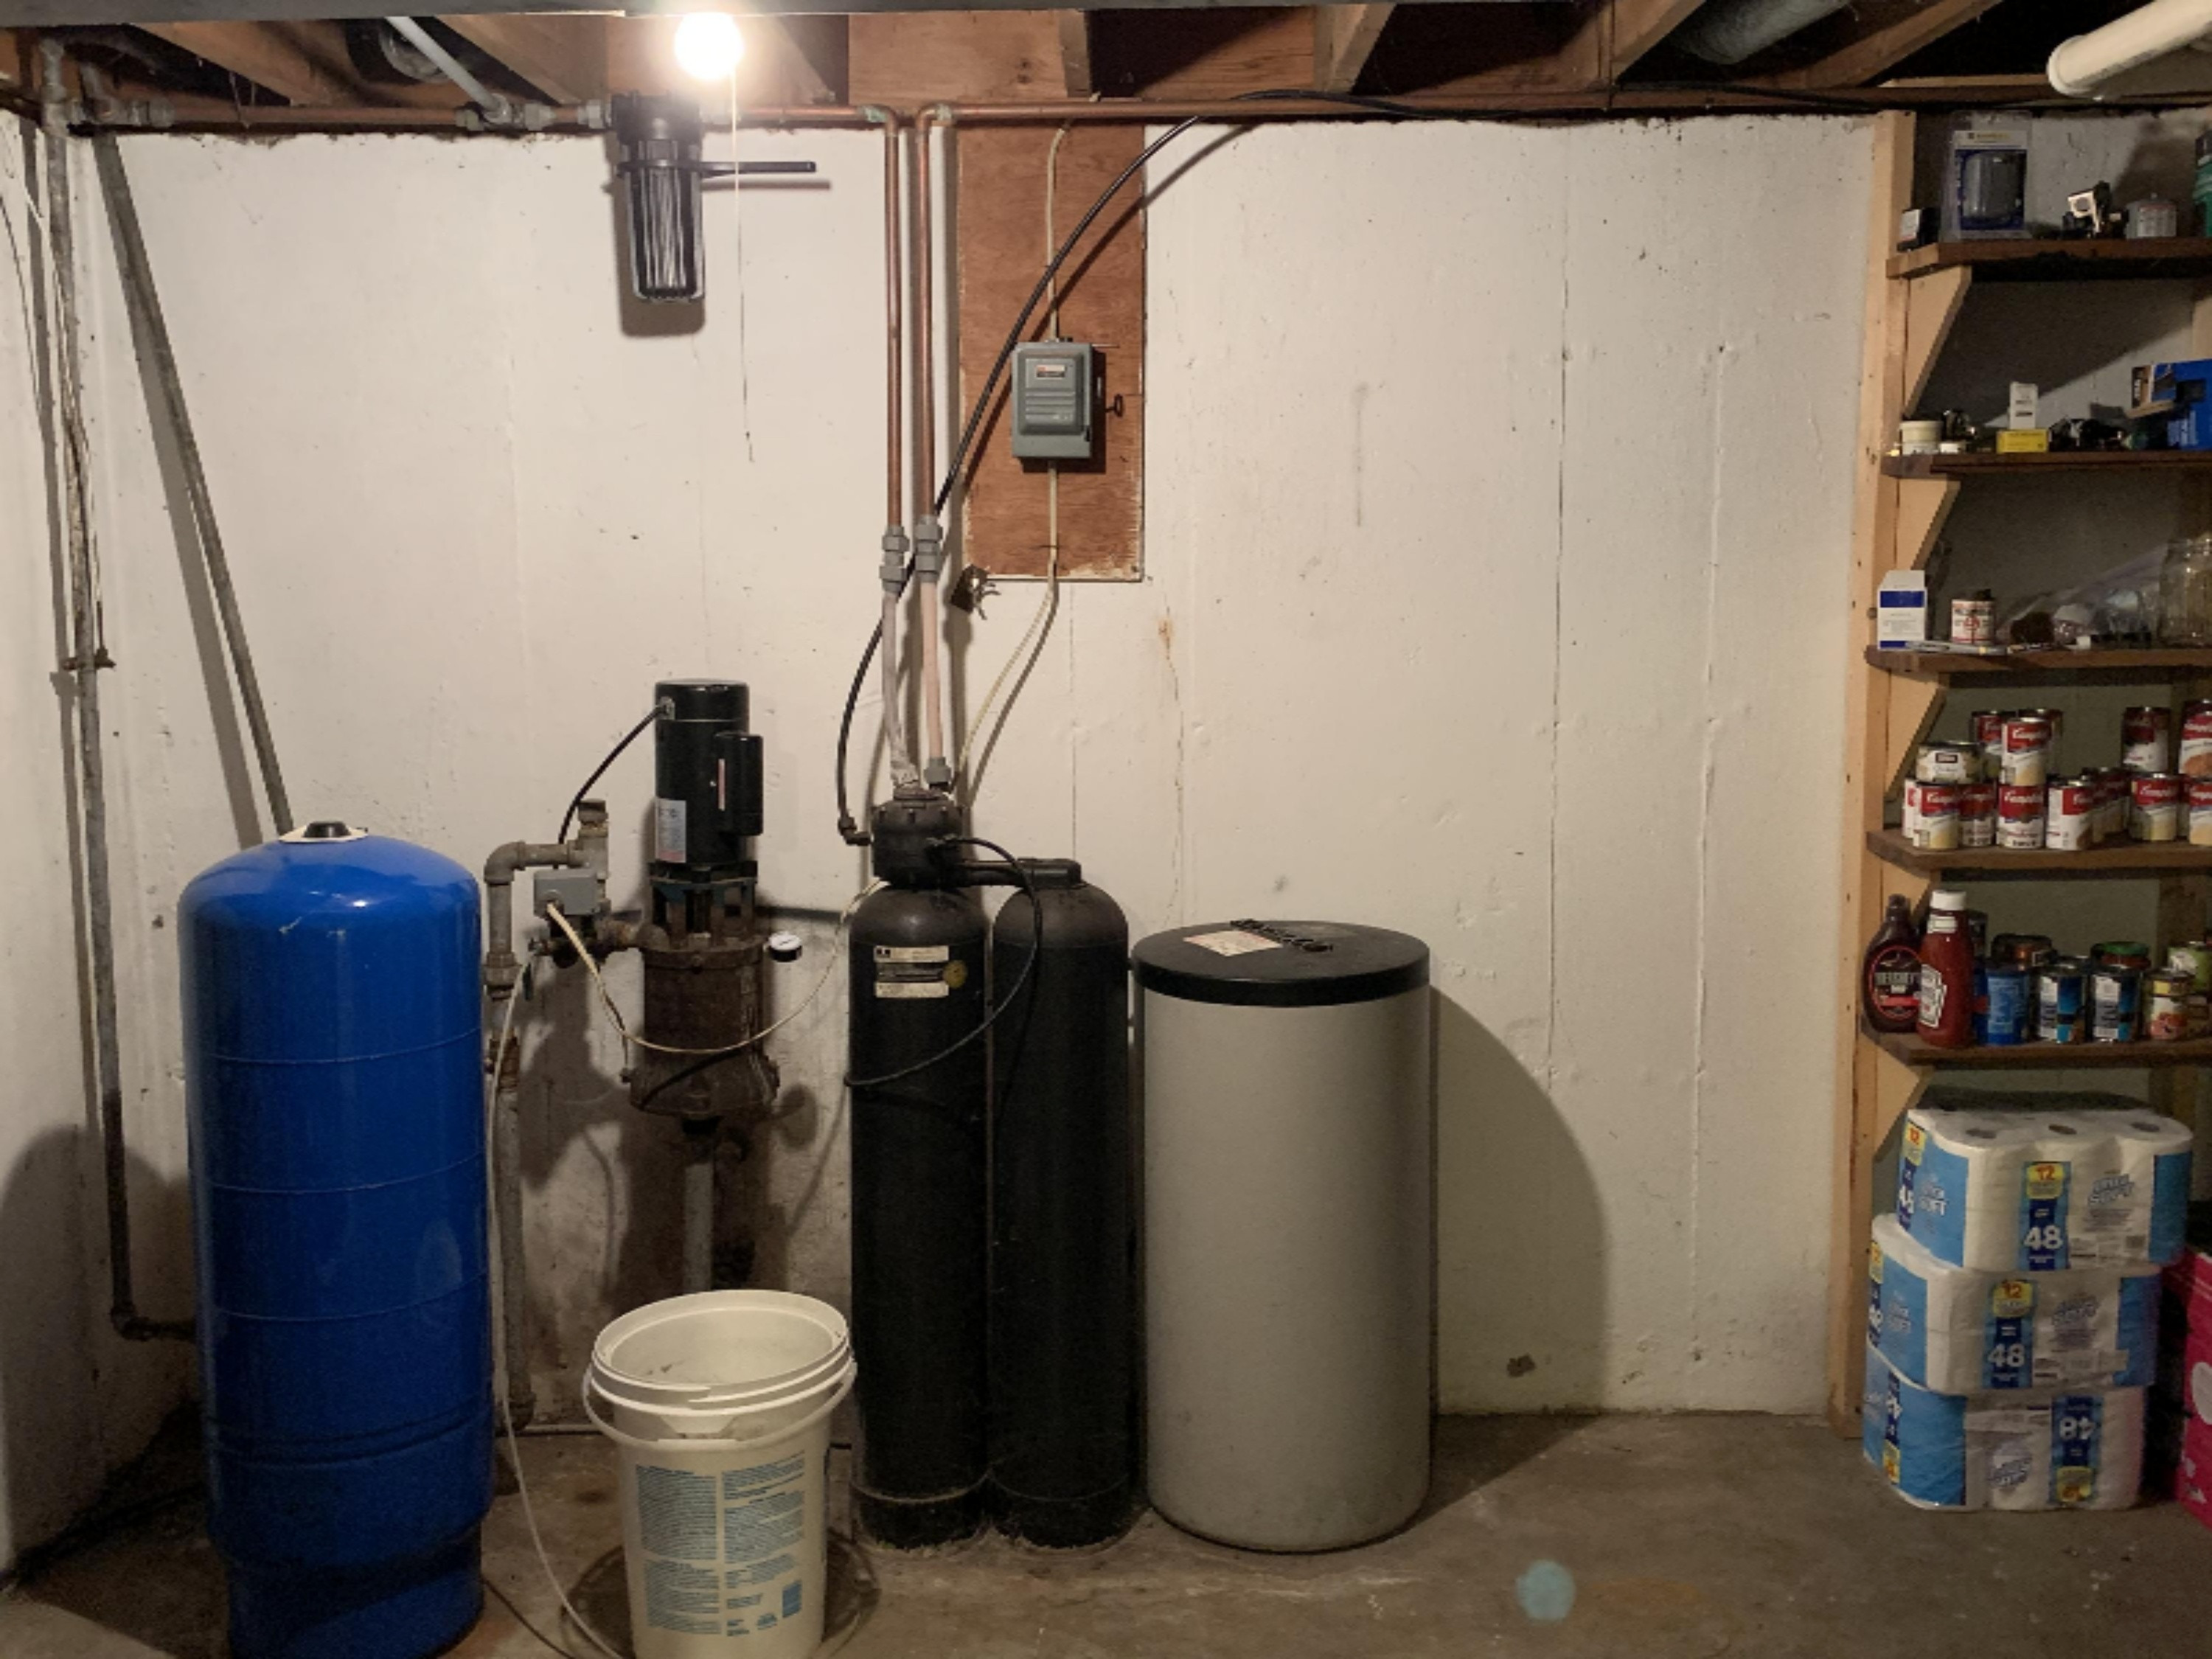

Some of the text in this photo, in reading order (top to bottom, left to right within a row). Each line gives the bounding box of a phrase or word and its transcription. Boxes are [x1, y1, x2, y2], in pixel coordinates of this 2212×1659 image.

[2036, 1164, 2056, 1180] 12
[2023, 1224, 2063, 1251] 48
[2003, 1279, 2022, 1298] 12
[1987, 1343, 2025, 1367] 48
[2059, 1416, 2096, 1440] 48
